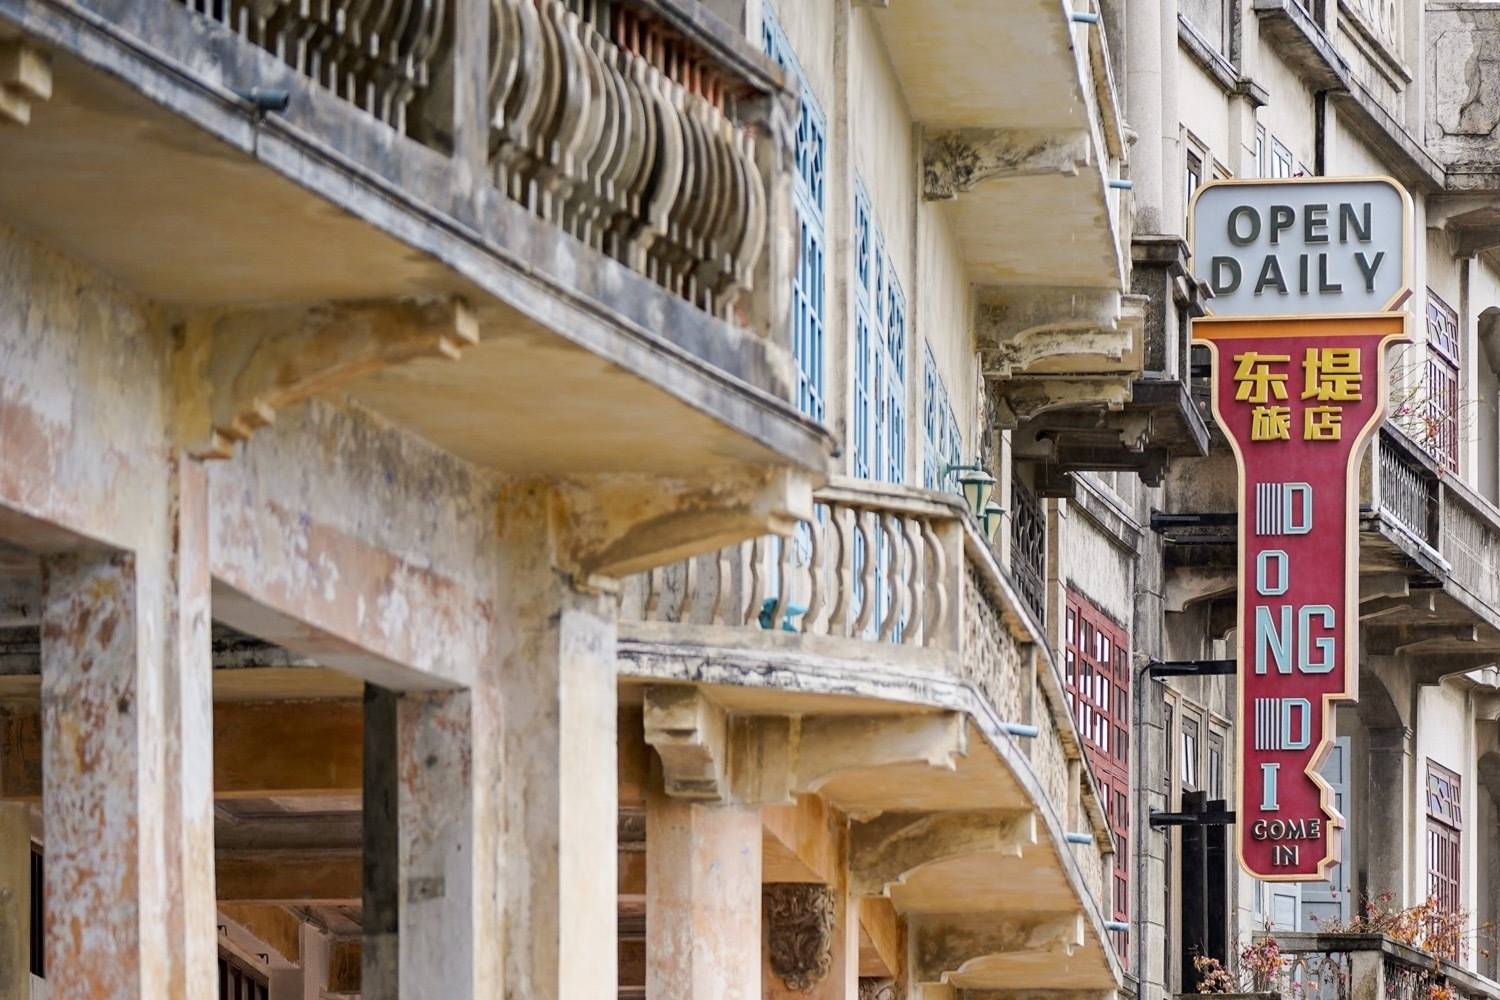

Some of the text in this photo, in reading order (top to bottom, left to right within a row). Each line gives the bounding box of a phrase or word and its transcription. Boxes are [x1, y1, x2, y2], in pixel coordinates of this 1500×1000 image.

[1227, 202, 1373, 246] OPEN
[1211, 251, 1385, 296] DAILY
[1233, 347, 1363, 403] 东堤
[1251, 406, 1342, 441] 旅店
[1255, 482, 1336, 674] DONG
[1253, 818, 1321, 841] COME
[1271, 844, 1300, 866] IN
